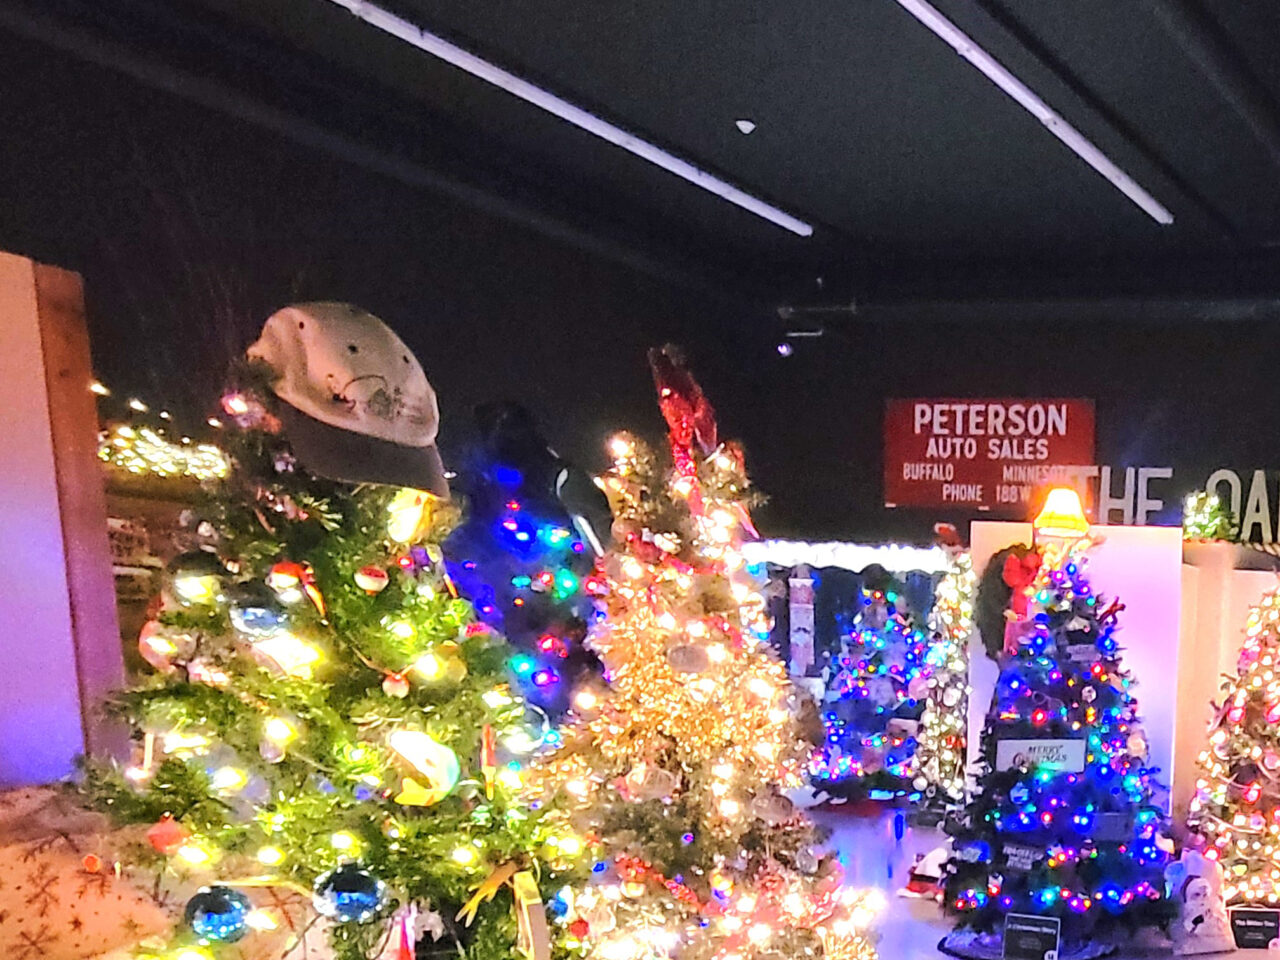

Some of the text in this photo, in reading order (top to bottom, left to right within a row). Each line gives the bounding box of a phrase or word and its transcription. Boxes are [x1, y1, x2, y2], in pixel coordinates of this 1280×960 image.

[914, 404, 1068, 436] PETERSON
[926, 438, 1049, 460] AUTO SALES
[903, 463, 954, 480] BUFFALO
[943, 483, 983, 502] PHONE
